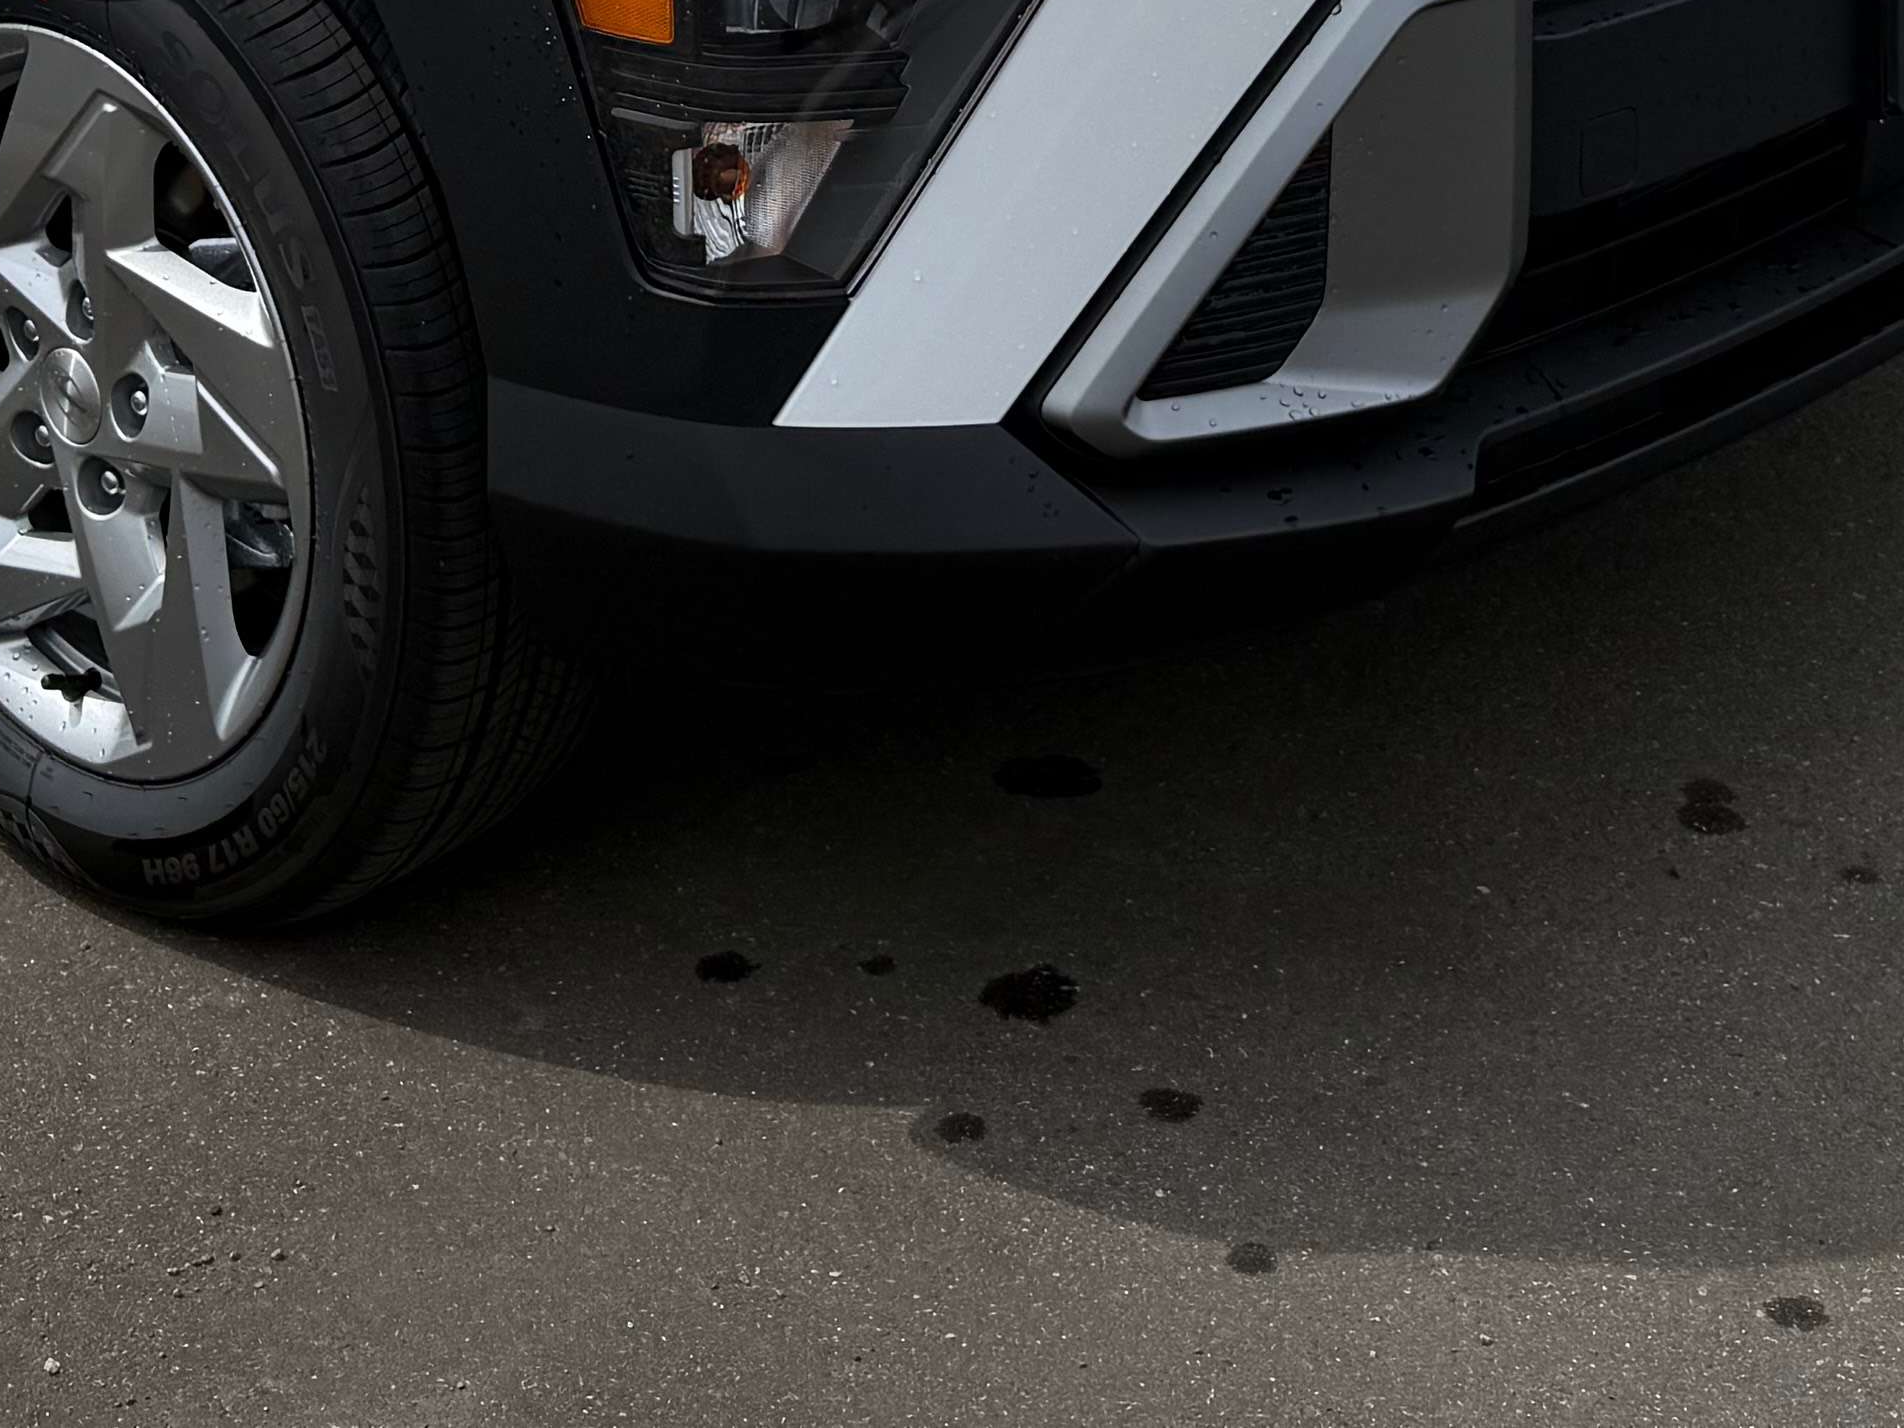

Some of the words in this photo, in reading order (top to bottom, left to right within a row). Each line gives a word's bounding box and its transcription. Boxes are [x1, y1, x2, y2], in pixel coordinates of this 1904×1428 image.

[256, 726, 328, 836] 215/60
[142, 853, 201, 887] 96H
[208, 824, 259, 876] R17
